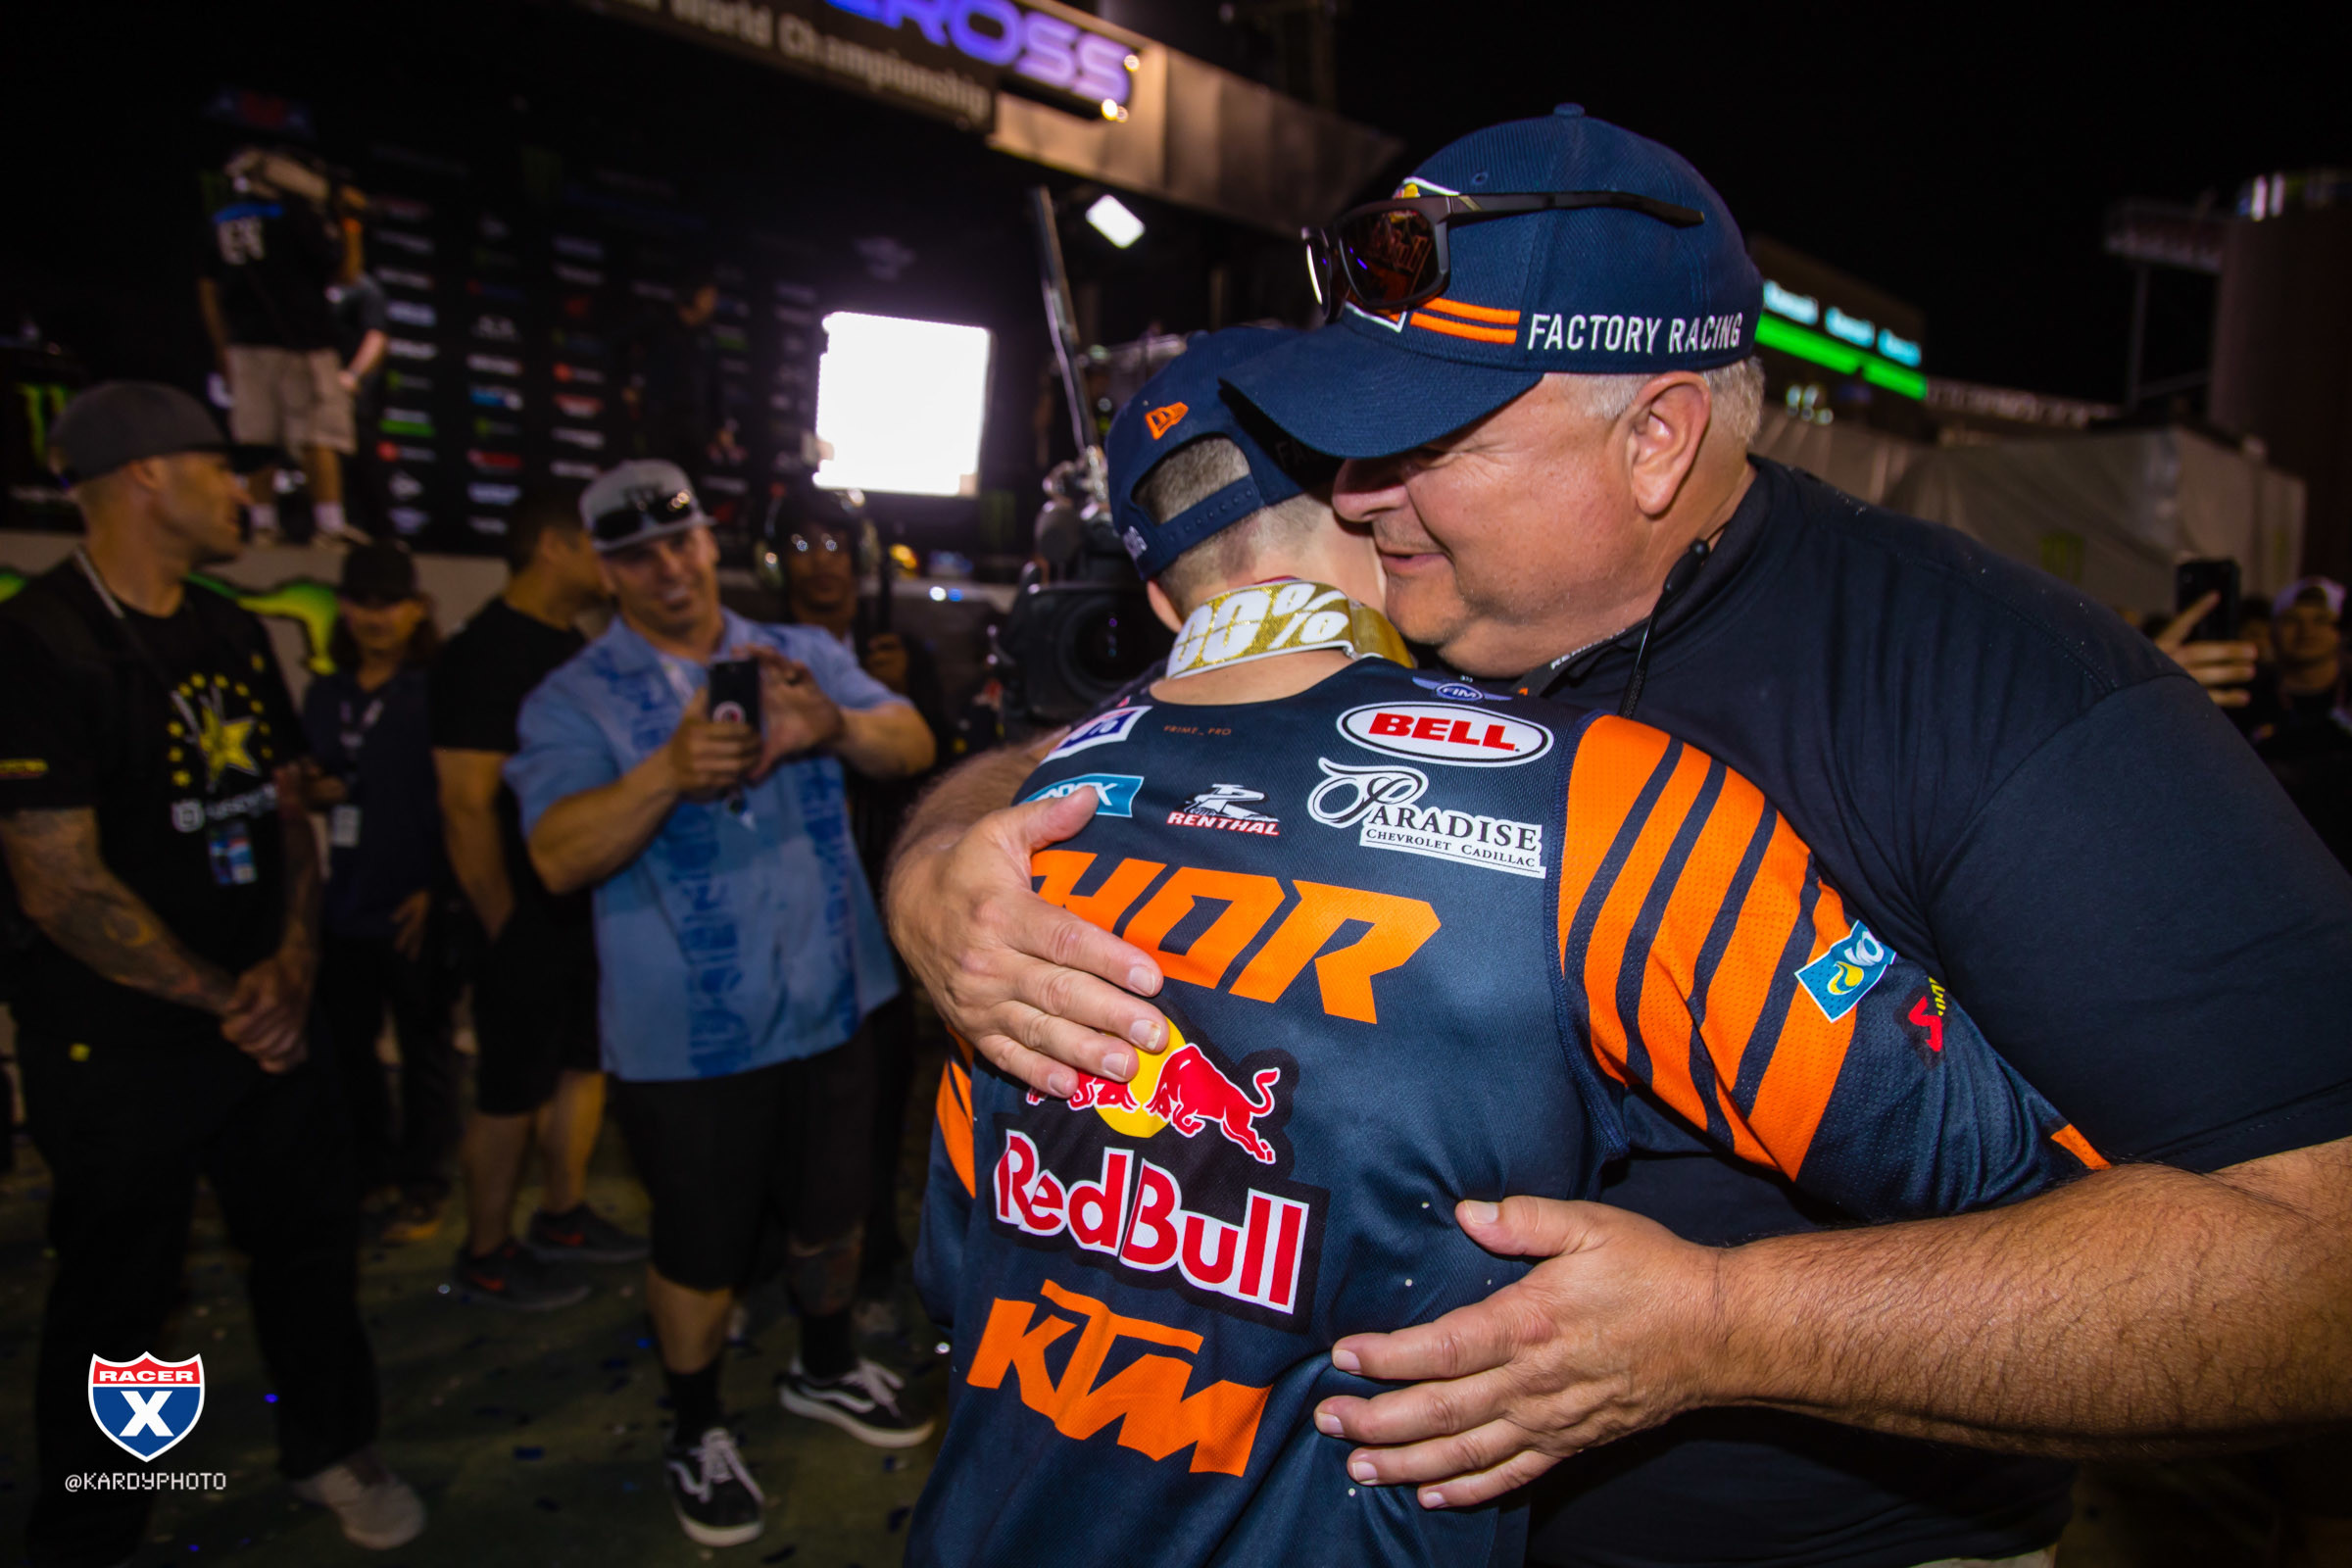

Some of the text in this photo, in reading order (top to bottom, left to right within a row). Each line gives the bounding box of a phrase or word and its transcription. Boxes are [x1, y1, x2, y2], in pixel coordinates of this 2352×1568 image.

[1528, 314, 1661, 355] FACTORY
[1668, 313, 1743, 354] RACING
[1442, 687, 1477, 699] FIM
[1368, 712, 1515, 752] BELL
[1166, 810, 1281, 837] RENTHAL
[1032, 850, 1442, 1024] HOR
[966, 1278, 1273, 1477] KTM
